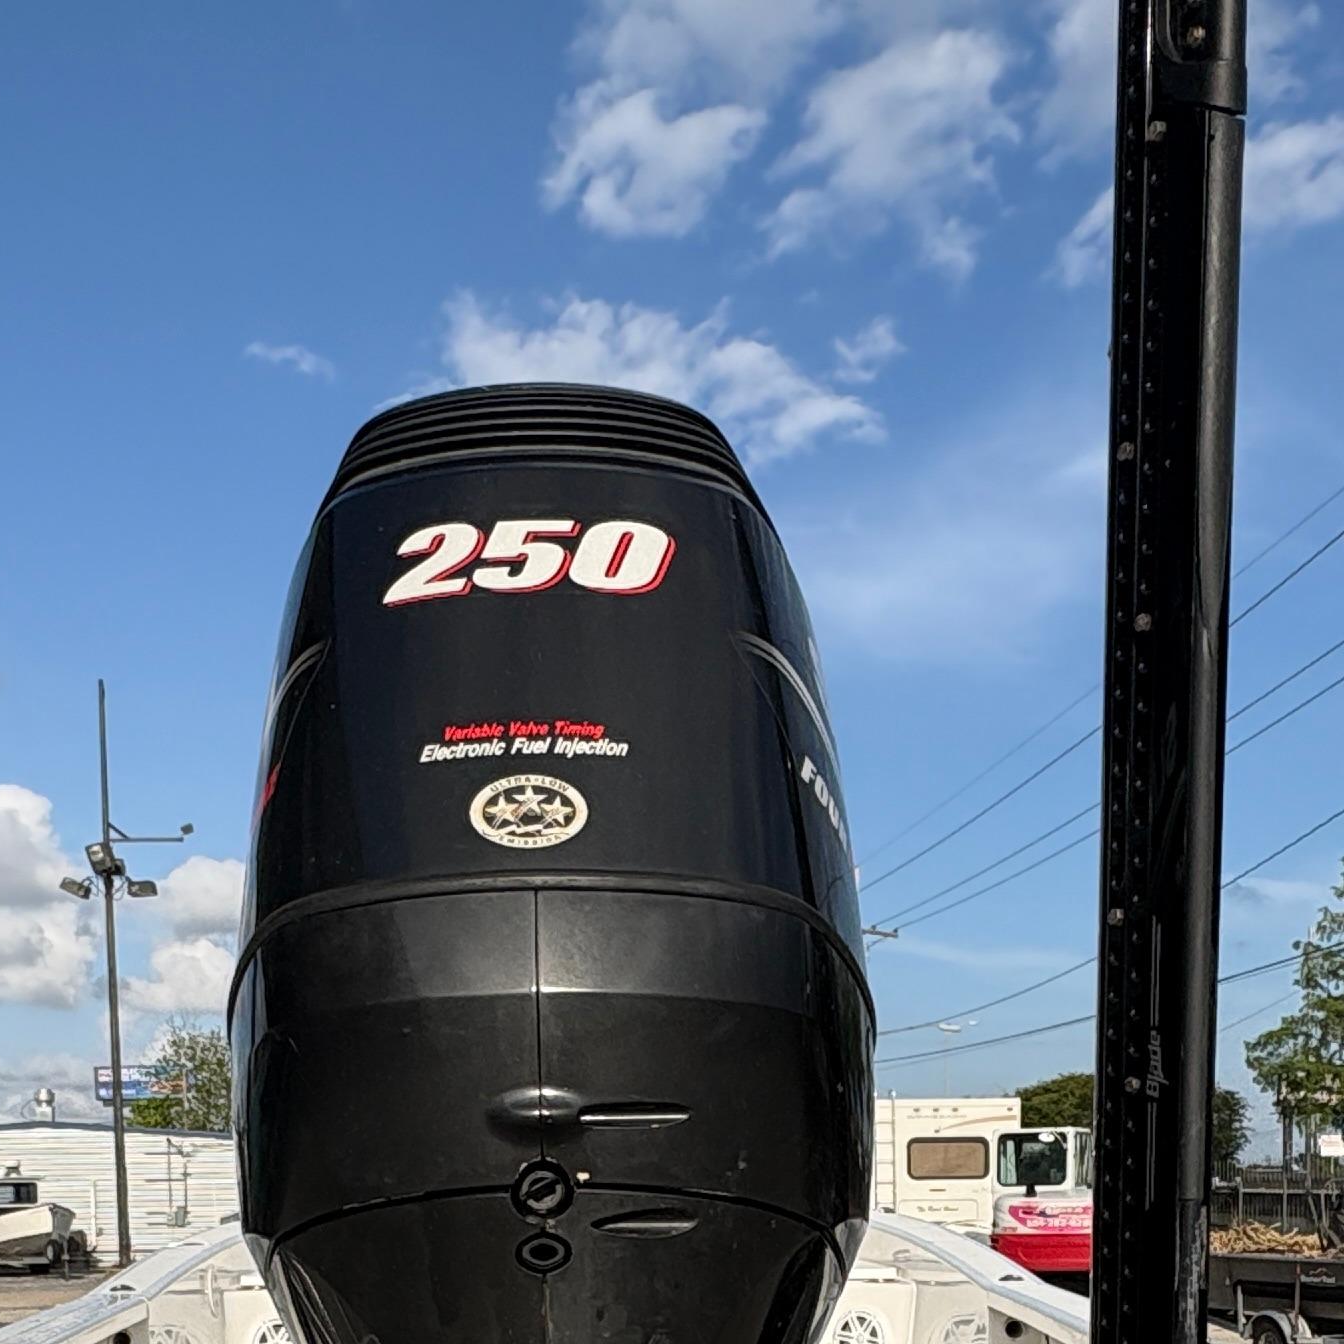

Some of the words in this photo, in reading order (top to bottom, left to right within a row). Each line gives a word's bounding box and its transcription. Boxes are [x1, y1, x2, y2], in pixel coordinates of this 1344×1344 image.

[382, 520, 677, 608] 250
[419, 739, 506, 763] Electronic
[511, 737, 552, 754] Fuel
[554, 738, 629, 758] Injection
[444, 722, 504, 741] Variable
[509, 721, 549, 737] Valve
[554, 720, 605, 738] Timing
[1146, 1030, 1169, 1098] Blade
